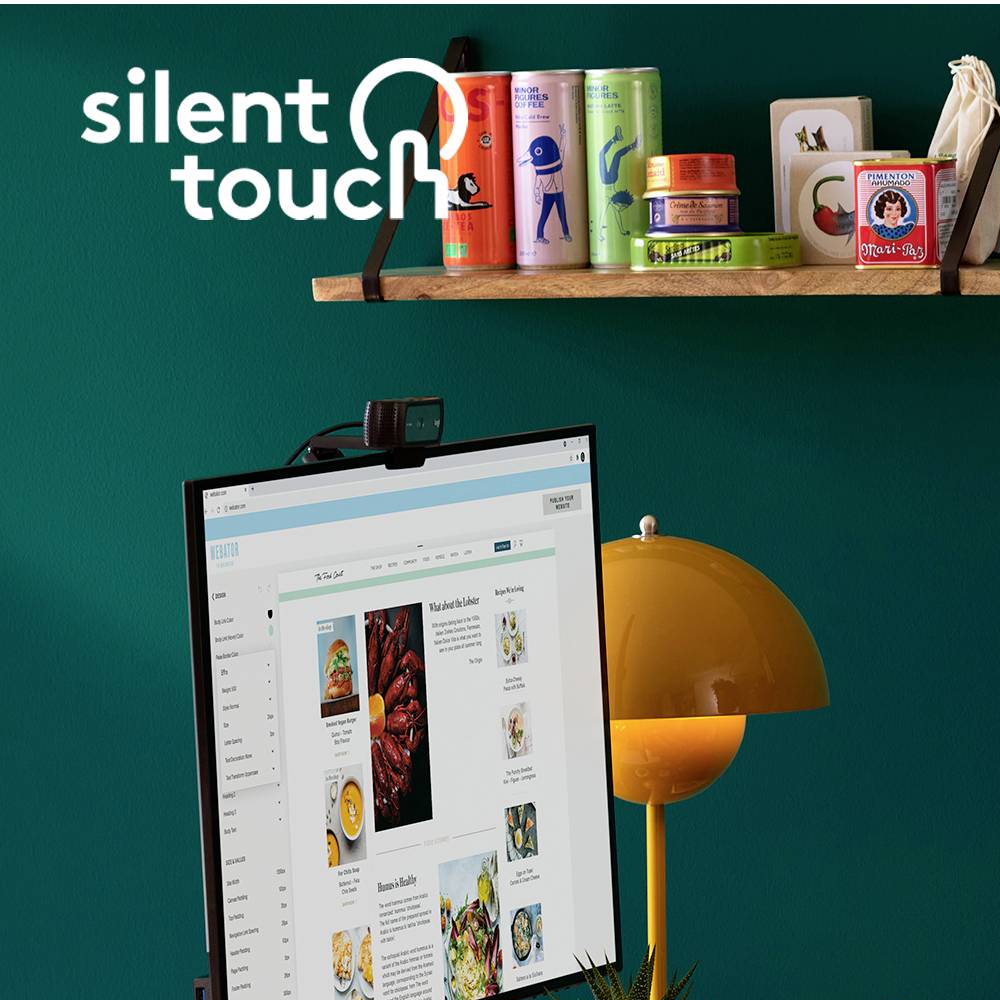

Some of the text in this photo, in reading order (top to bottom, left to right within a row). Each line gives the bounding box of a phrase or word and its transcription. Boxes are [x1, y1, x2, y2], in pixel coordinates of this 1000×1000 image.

[210, 542, 239, 560] WEBATOR
[428, 602, 440, 612] What
[442, 600, 454, 611] about
[463, 595, 479, 607] Lobster
